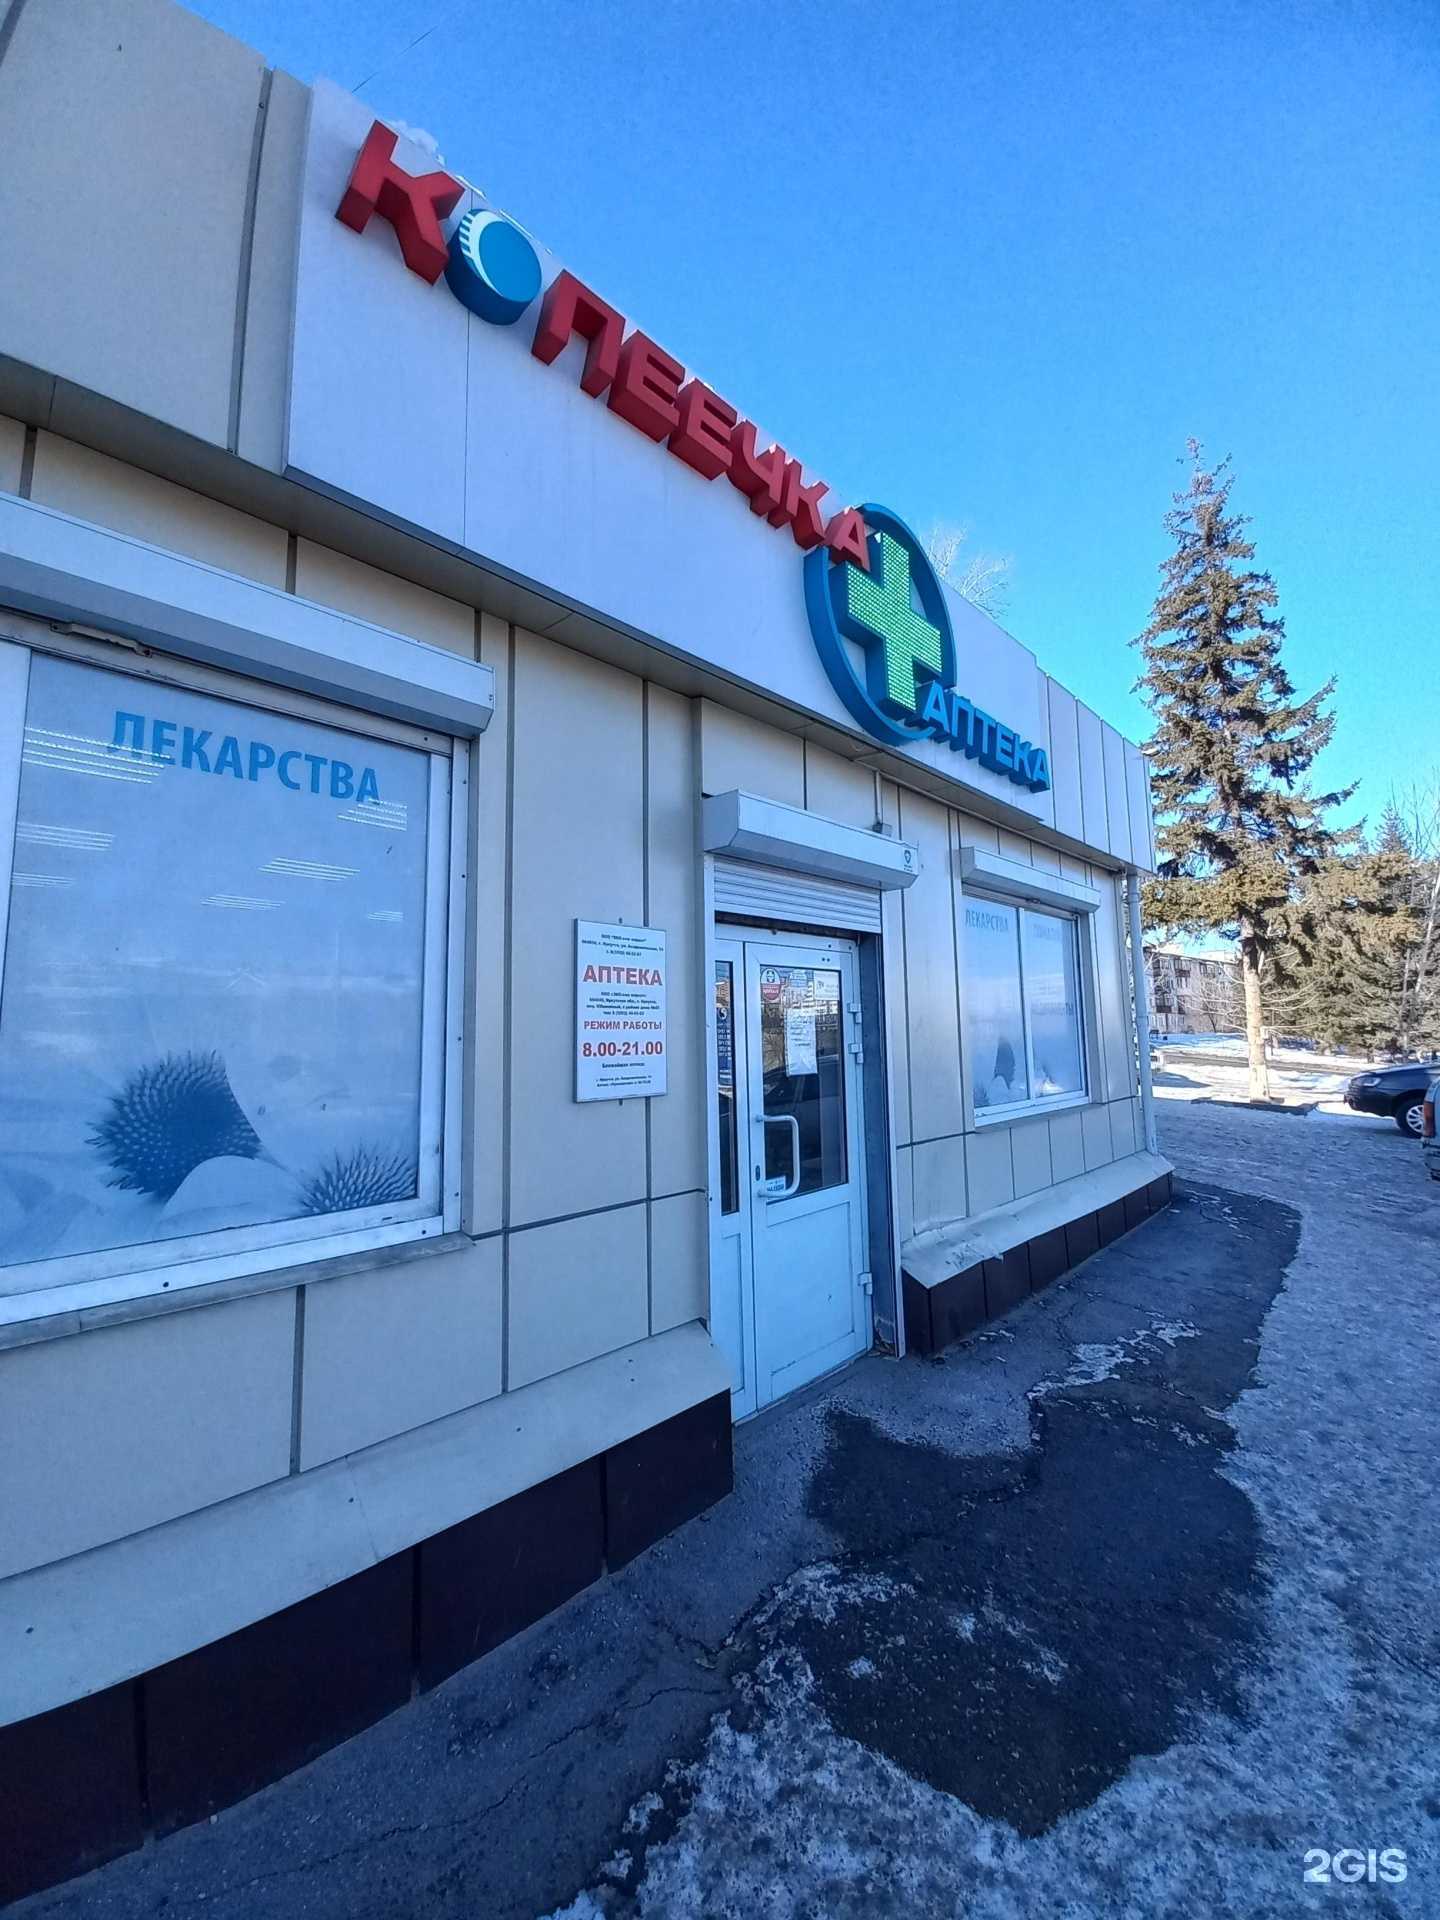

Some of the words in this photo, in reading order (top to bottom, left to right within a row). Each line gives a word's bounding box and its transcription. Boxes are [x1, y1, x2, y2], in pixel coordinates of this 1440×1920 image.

[335, 119, 870, 572] КОПЕЕЧКА
[109, 711, 380, 804] ЛЕКАРСТВА
[920, 680, 1051, 793] АПТЕКА
[583, 964, 663, 986] АПТЕКА
[582, 1041, 663, 1057] 8.00-21.00
[583, 1021, 620, 1030] РЕЖИМ
[623, 1021, 662, 1030] РАБОТЫ
